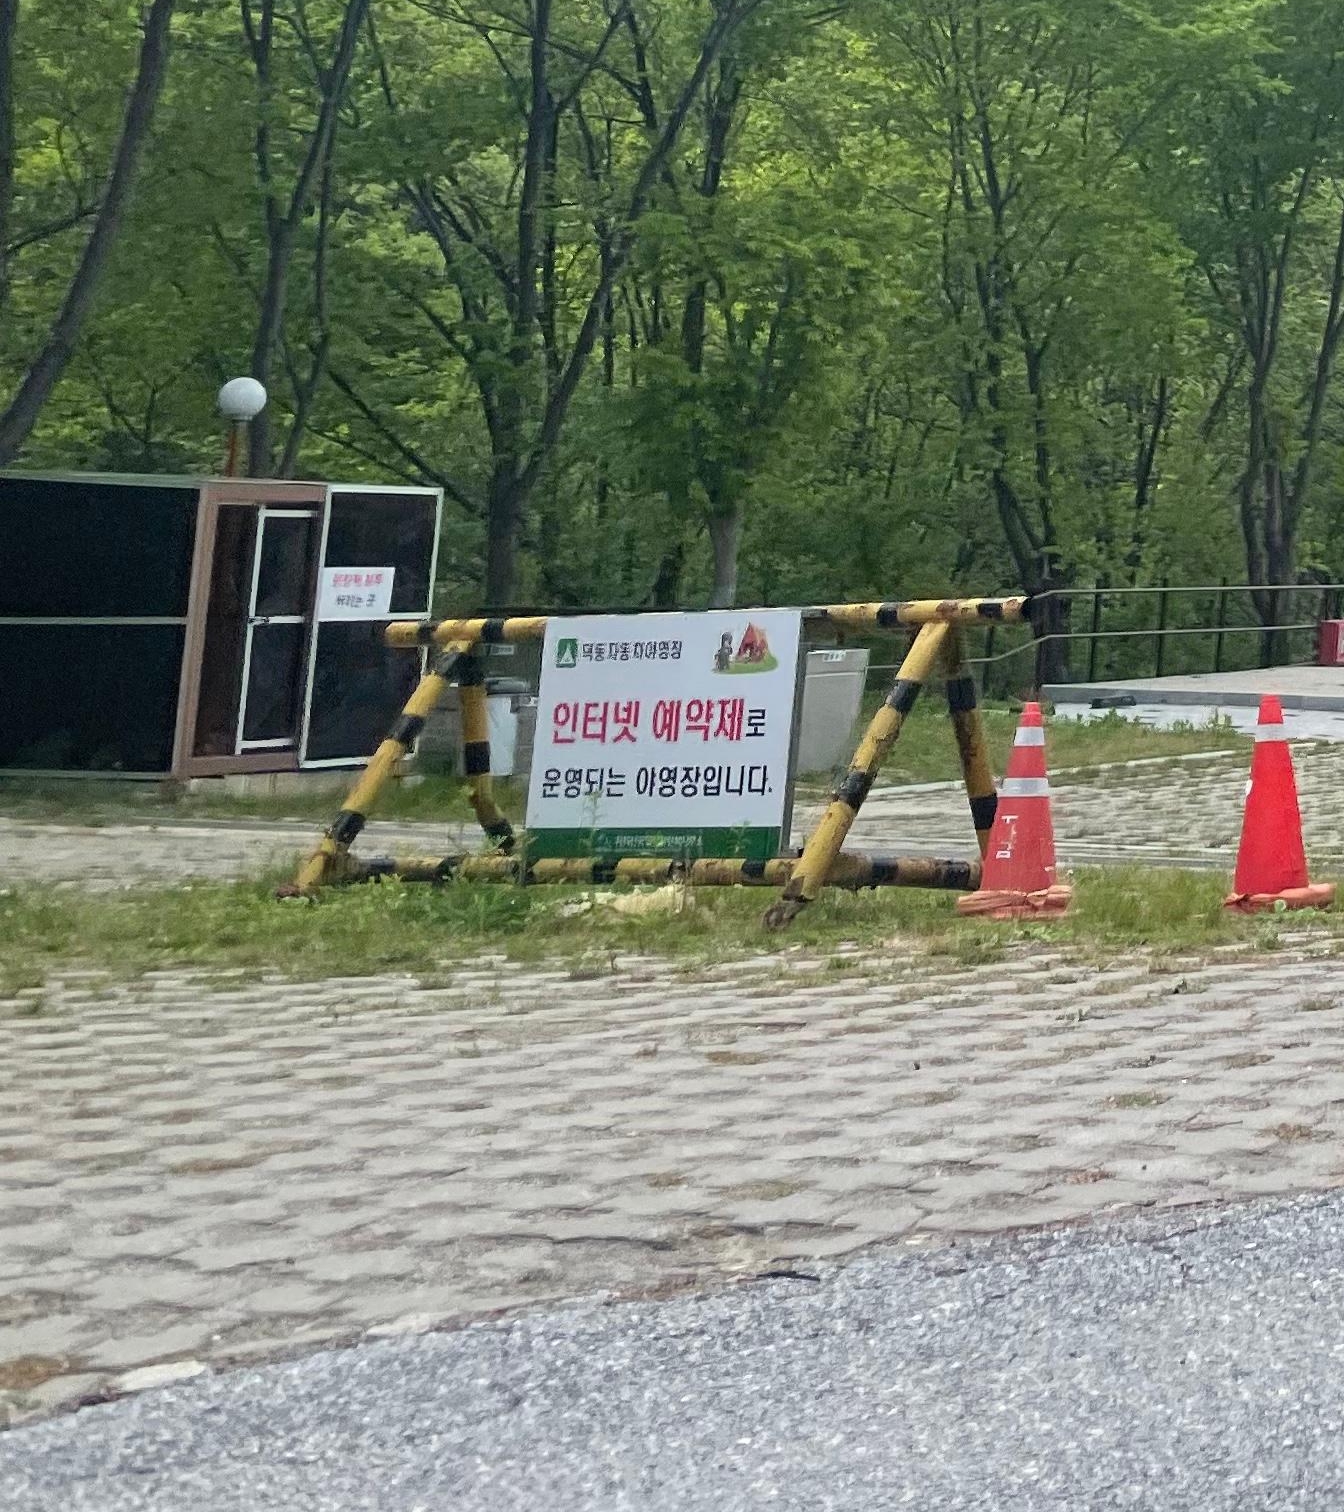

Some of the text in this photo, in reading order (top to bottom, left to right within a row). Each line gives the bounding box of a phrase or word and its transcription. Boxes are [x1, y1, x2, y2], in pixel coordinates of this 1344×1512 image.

[553, 698, 766, 744] 인터넷 예약제로
[541, 765, 772, 798] 운영되는 야영장입니다.
